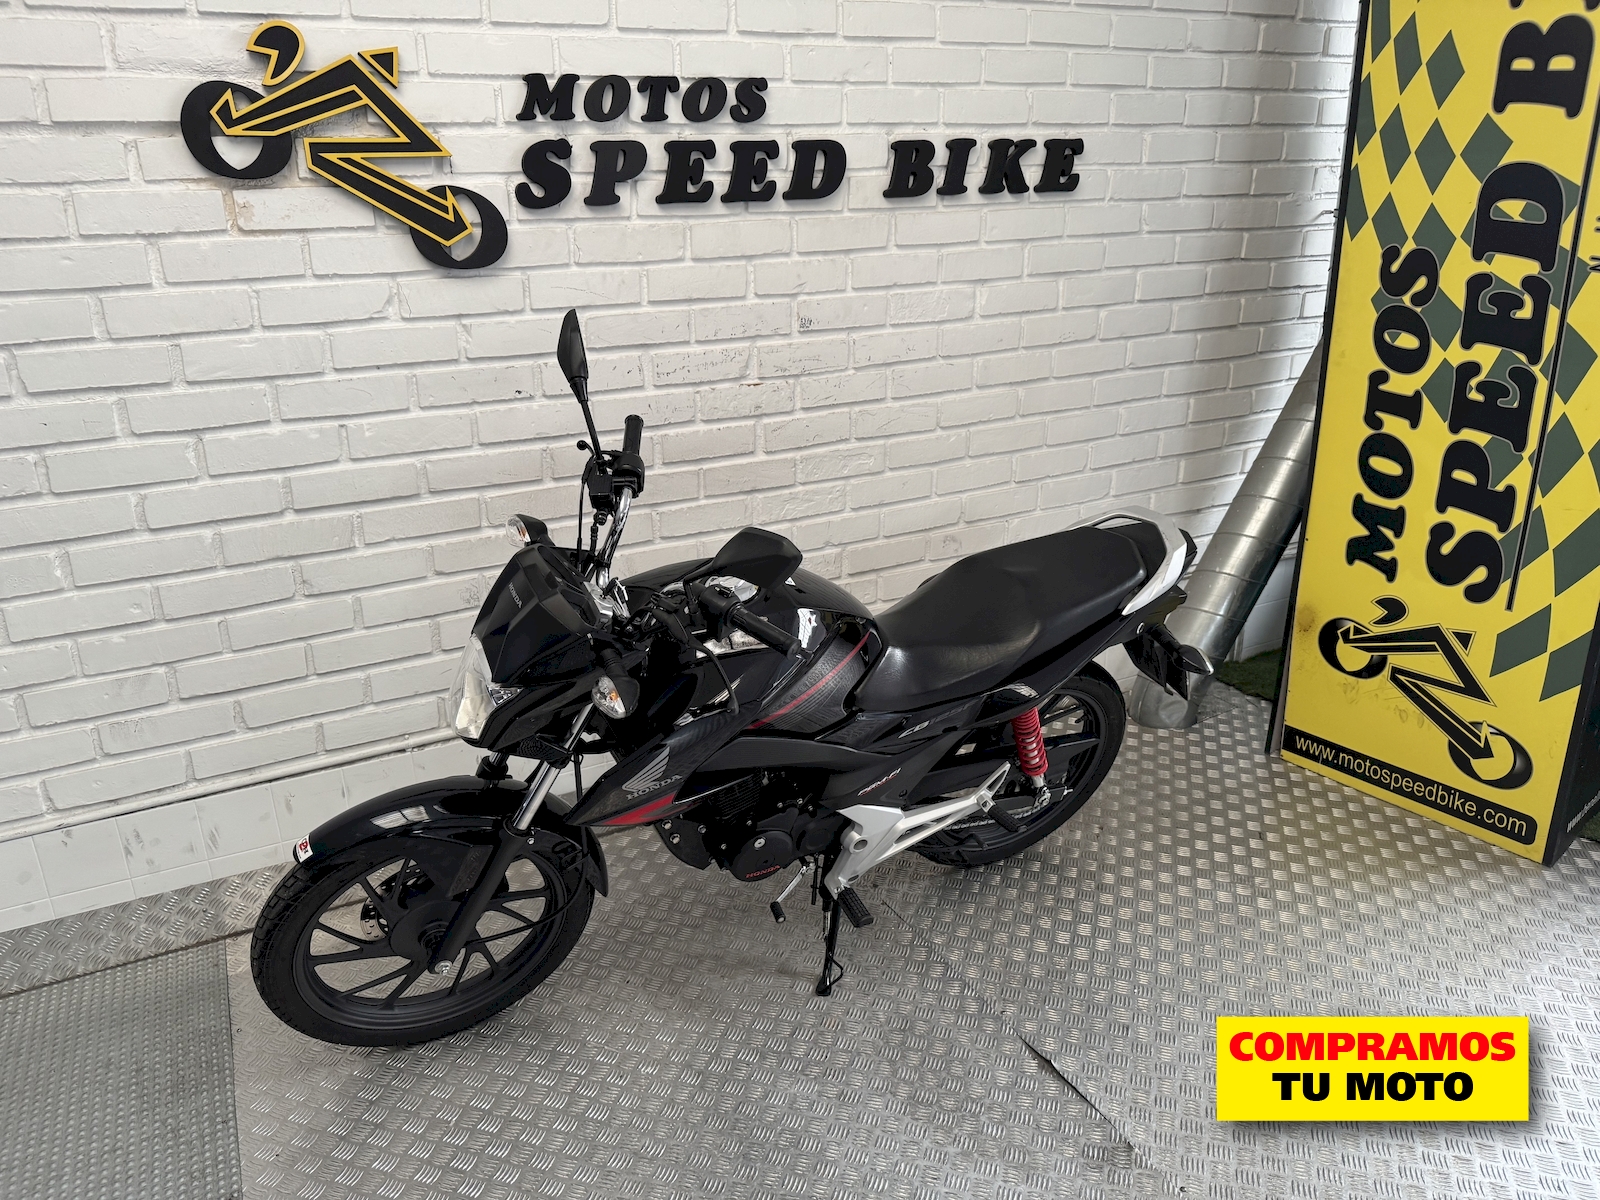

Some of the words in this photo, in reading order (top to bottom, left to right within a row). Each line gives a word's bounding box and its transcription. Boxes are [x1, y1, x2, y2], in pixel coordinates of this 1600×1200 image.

[1491, 0, 1600, 120] B
[515, 72, 768, 123] MOTOS
[514, 138, 847, 209] SPEED
[882, 138, 1084, 199] BIKE
[1345, 244, 1440, 584] MOTOS
[1425, 160, 1566, 605] SPEED
[508, 581, 523, 609] HONDA
[625, 774, 683, 800] HONDA
[1295, 735, 1527, 837] www.motospeedbike.com
[745, 864, 781, 879] HONDA
